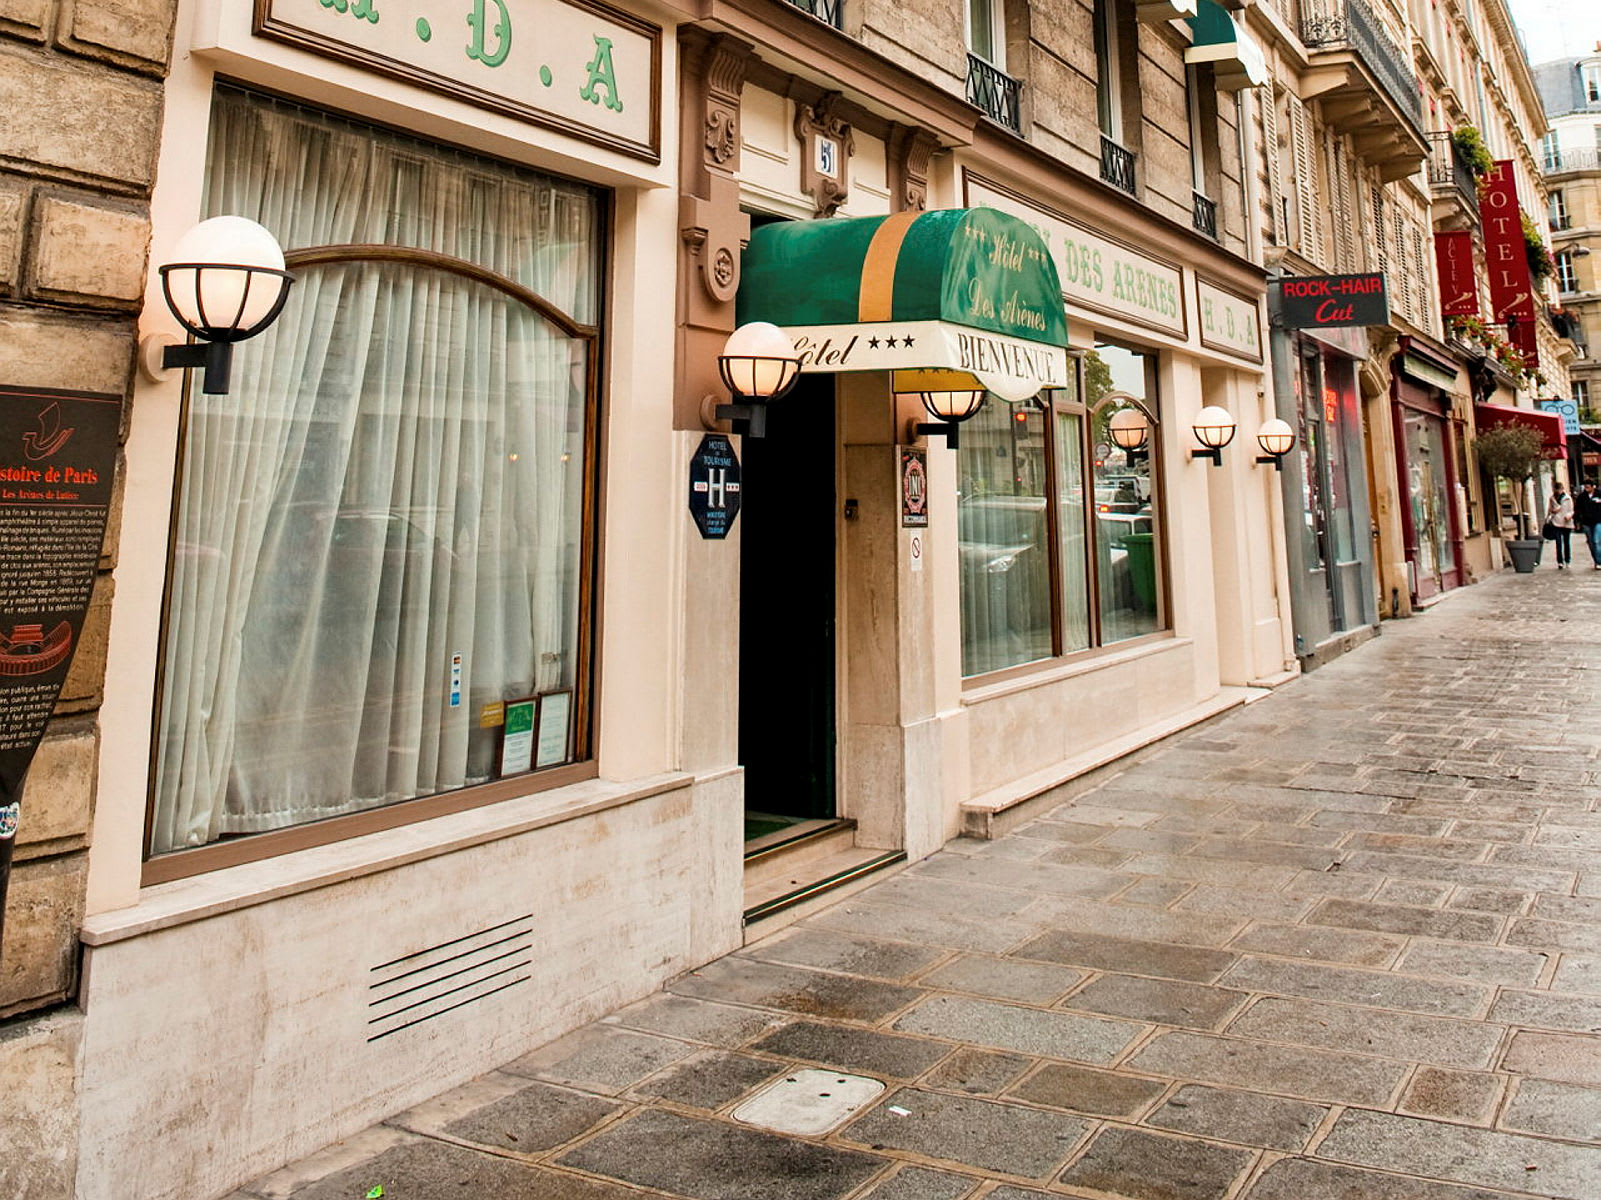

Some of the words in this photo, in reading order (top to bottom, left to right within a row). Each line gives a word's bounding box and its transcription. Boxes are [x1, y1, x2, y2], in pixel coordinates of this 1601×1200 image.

[1485, 165, 1519, 288] HOTEL
[968, 278, 996, 321] Des
[1064, 239, 1103, 293] DES
[1113, 260, 1177, 319] ARENES
[1283, 277, 1382, 298] ROCK-HAIR
[1315, 299, 1355, 324] Cut
[957, 332, 1057, 384] BIENVENUE
[0, 465, 42, 482] stoire
[44, 465, 61, 483] de
[63, 466, 99, 485] Paris
[708, 468, 726, 508] H
